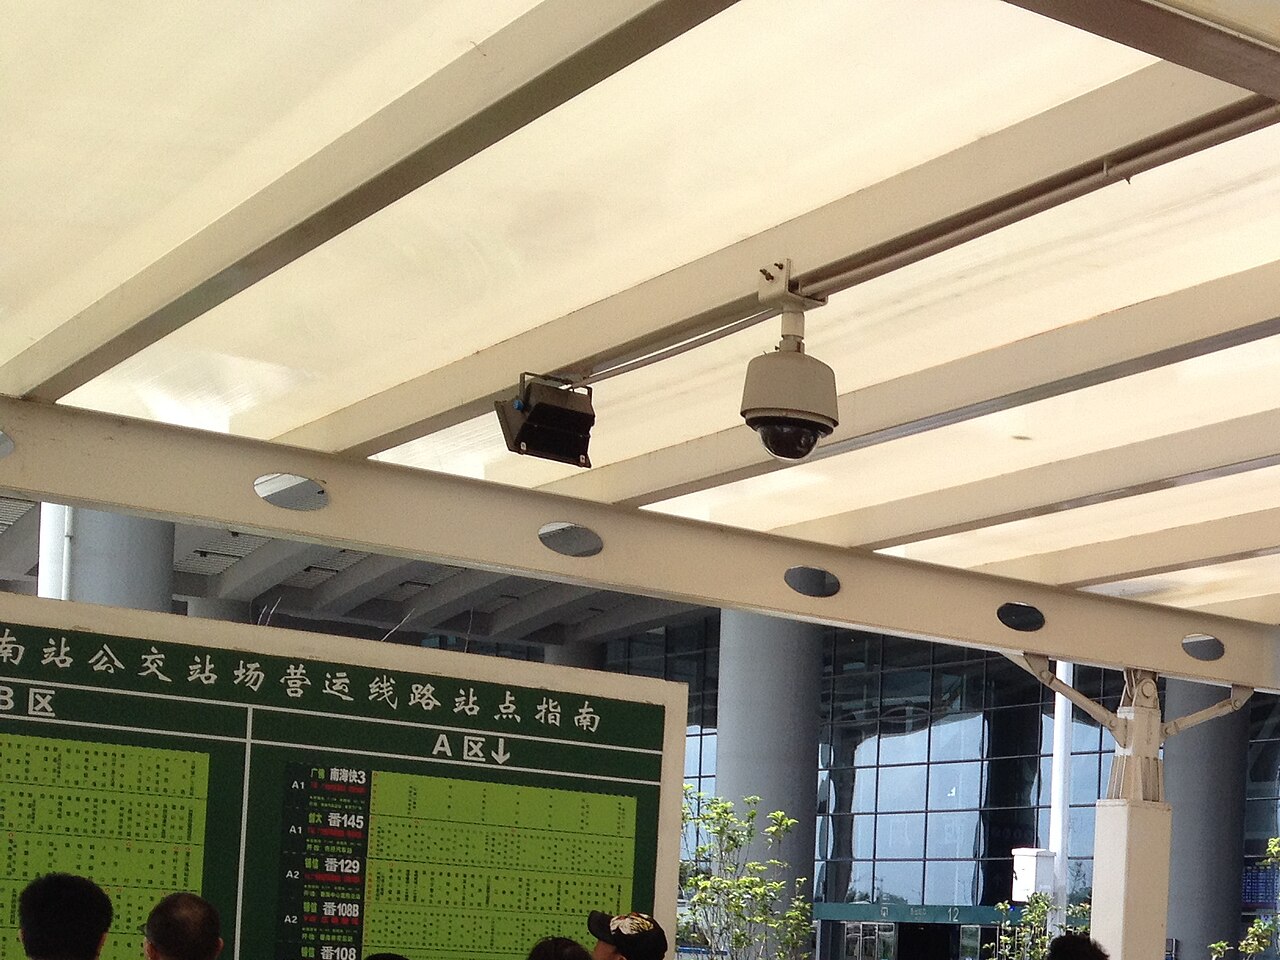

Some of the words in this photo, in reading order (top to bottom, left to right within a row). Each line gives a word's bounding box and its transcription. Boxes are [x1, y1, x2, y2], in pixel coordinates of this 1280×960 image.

[432, 734, 487, 762] A区
[330, 767, 366, 784] 南海快3
[291, 780, 305, 790] A1
[289, 824, 302, 834] A1
[327, 812, 364, 830] 番145
[324, 857, 360, 874] 番129
[285, 869, 300, 880] A2
[322, 901, 360, 918] 番108B
[948, 907, 960, 922] 12
[284, 914, 298, 924] A2
